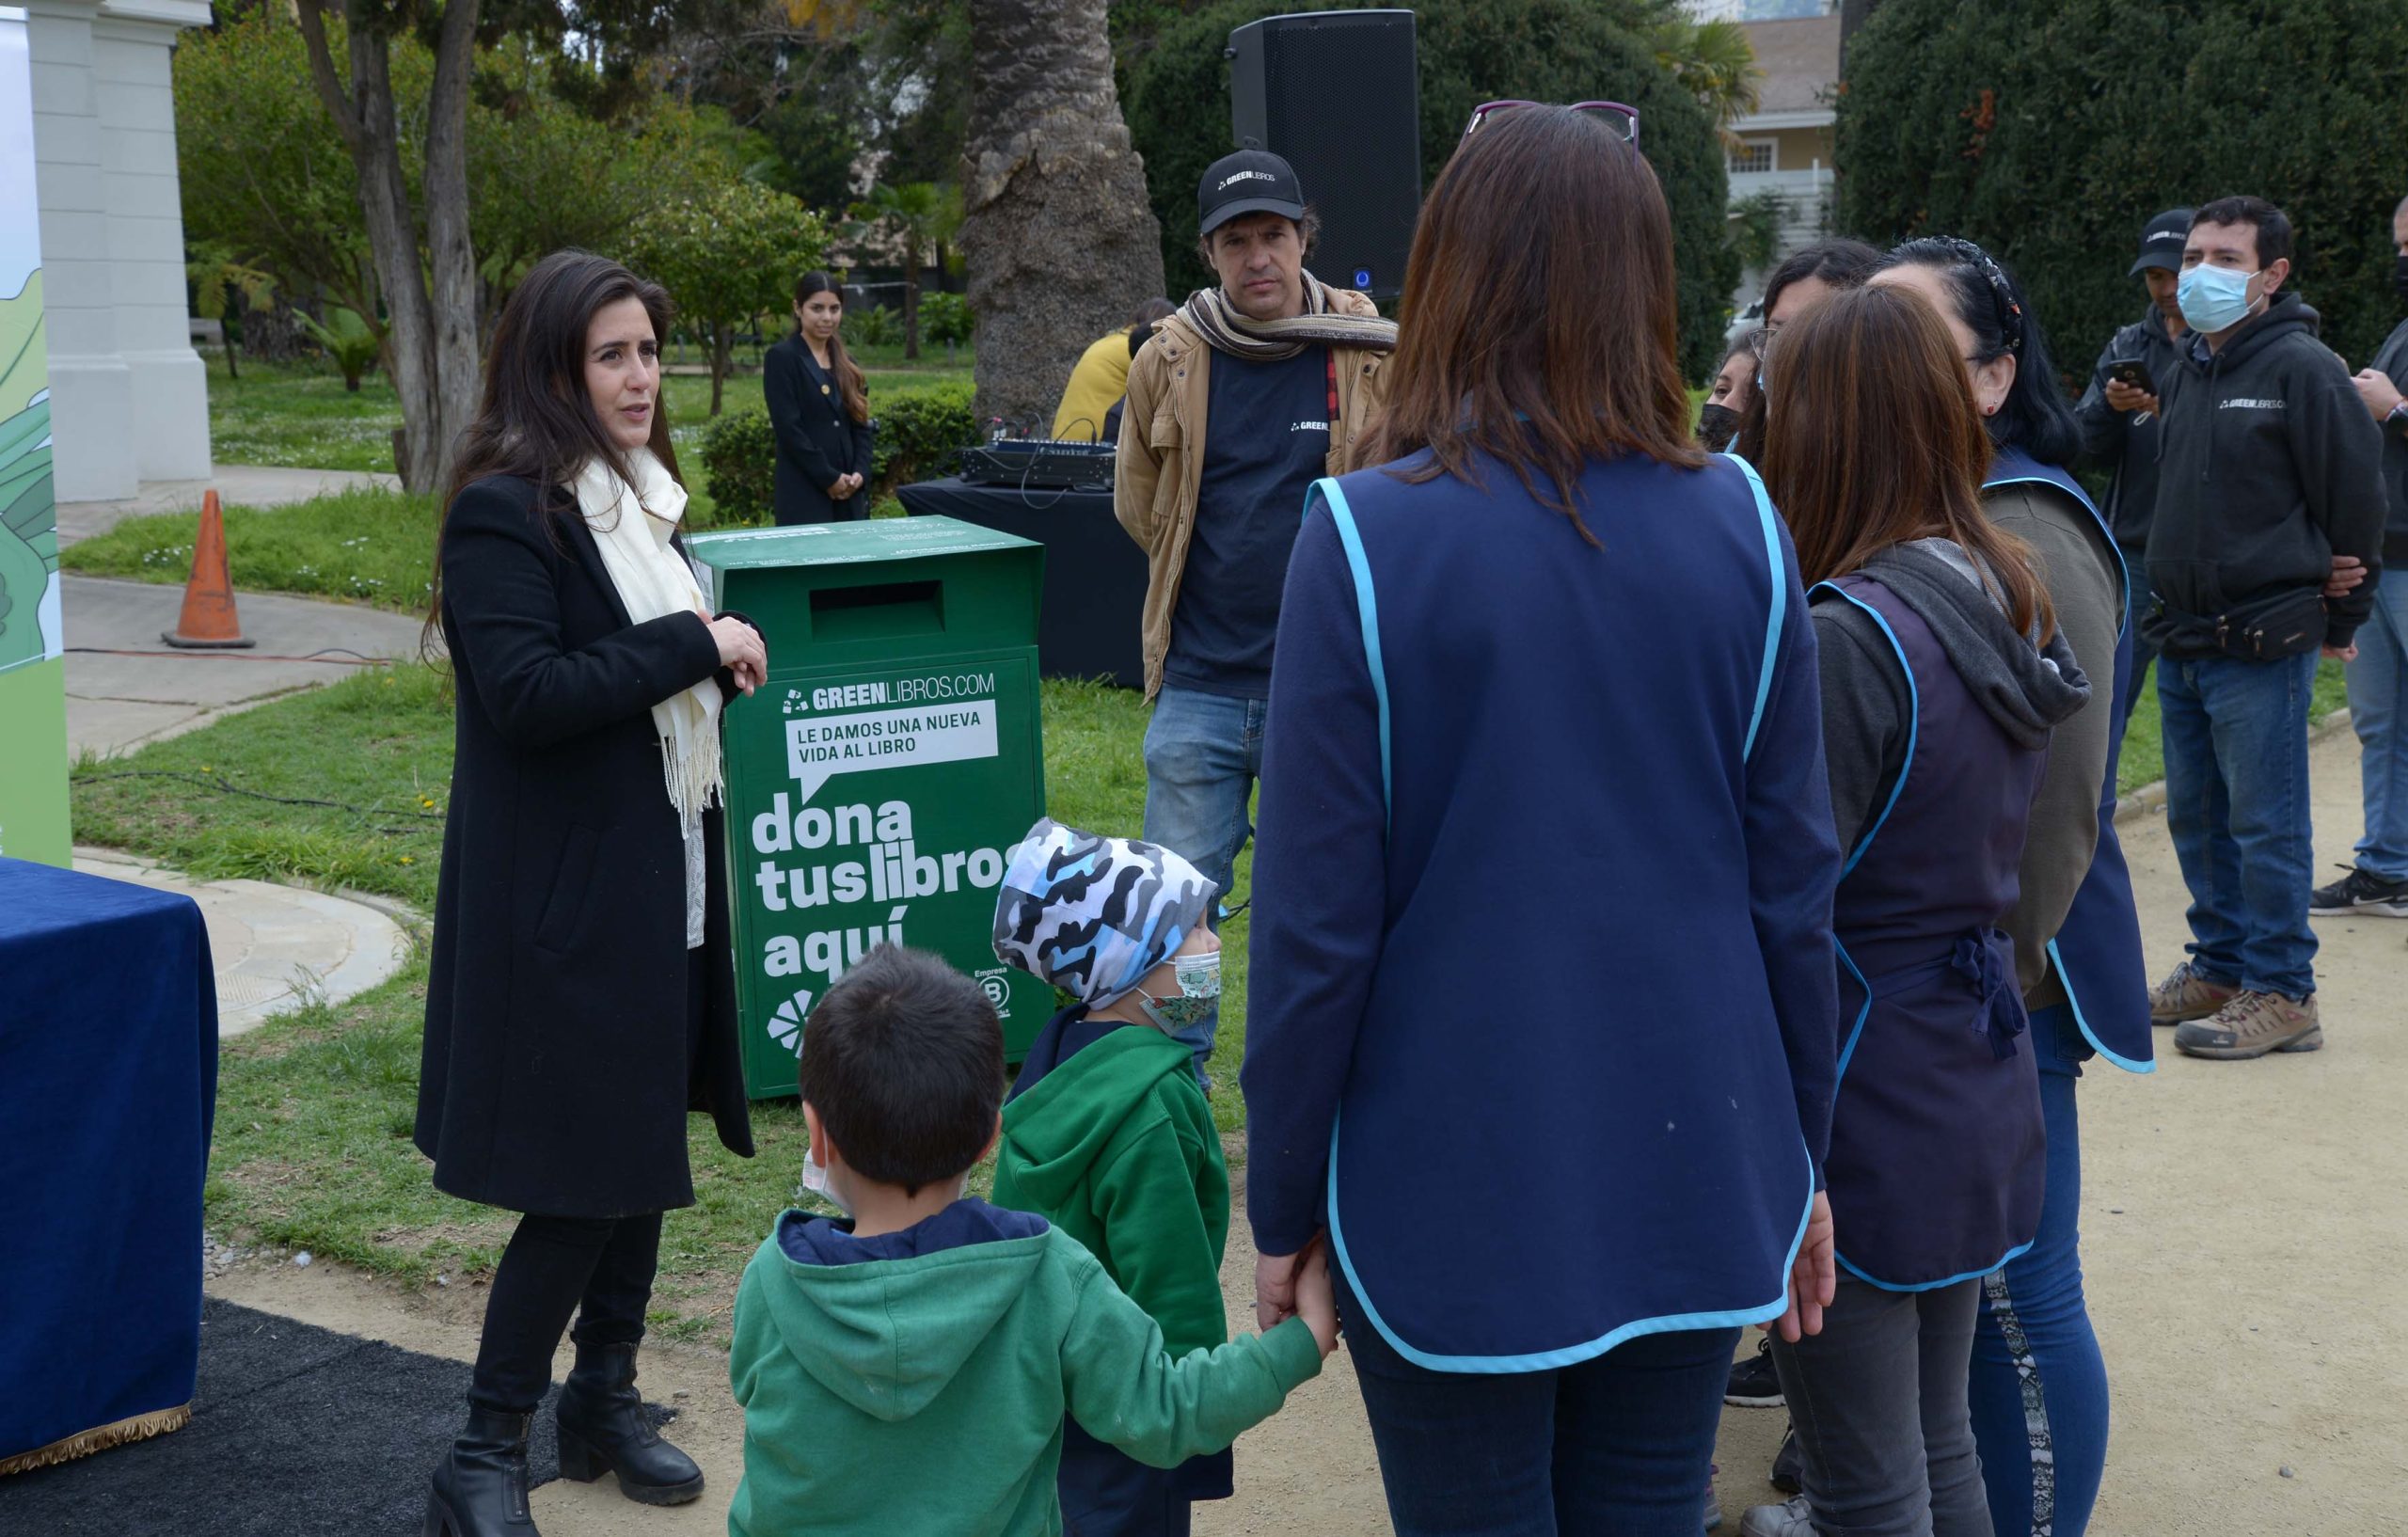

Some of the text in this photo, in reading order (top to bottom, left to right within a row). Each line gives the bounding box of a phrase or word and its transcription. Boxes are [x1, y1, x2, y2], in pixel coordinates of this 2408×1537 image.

[1227, 170, 1275, 185] GREENLIBROS
[813, 673, 995, 711] GREENLIBROS.COM
[797, 711, 981, 744] LE DAMOS UNA NUEVA
[799, 737, 916, 763] VIDA AL LIBRO
[752, 792, 912, 854] dona
[974, 967, 1007, 977] Empresa
